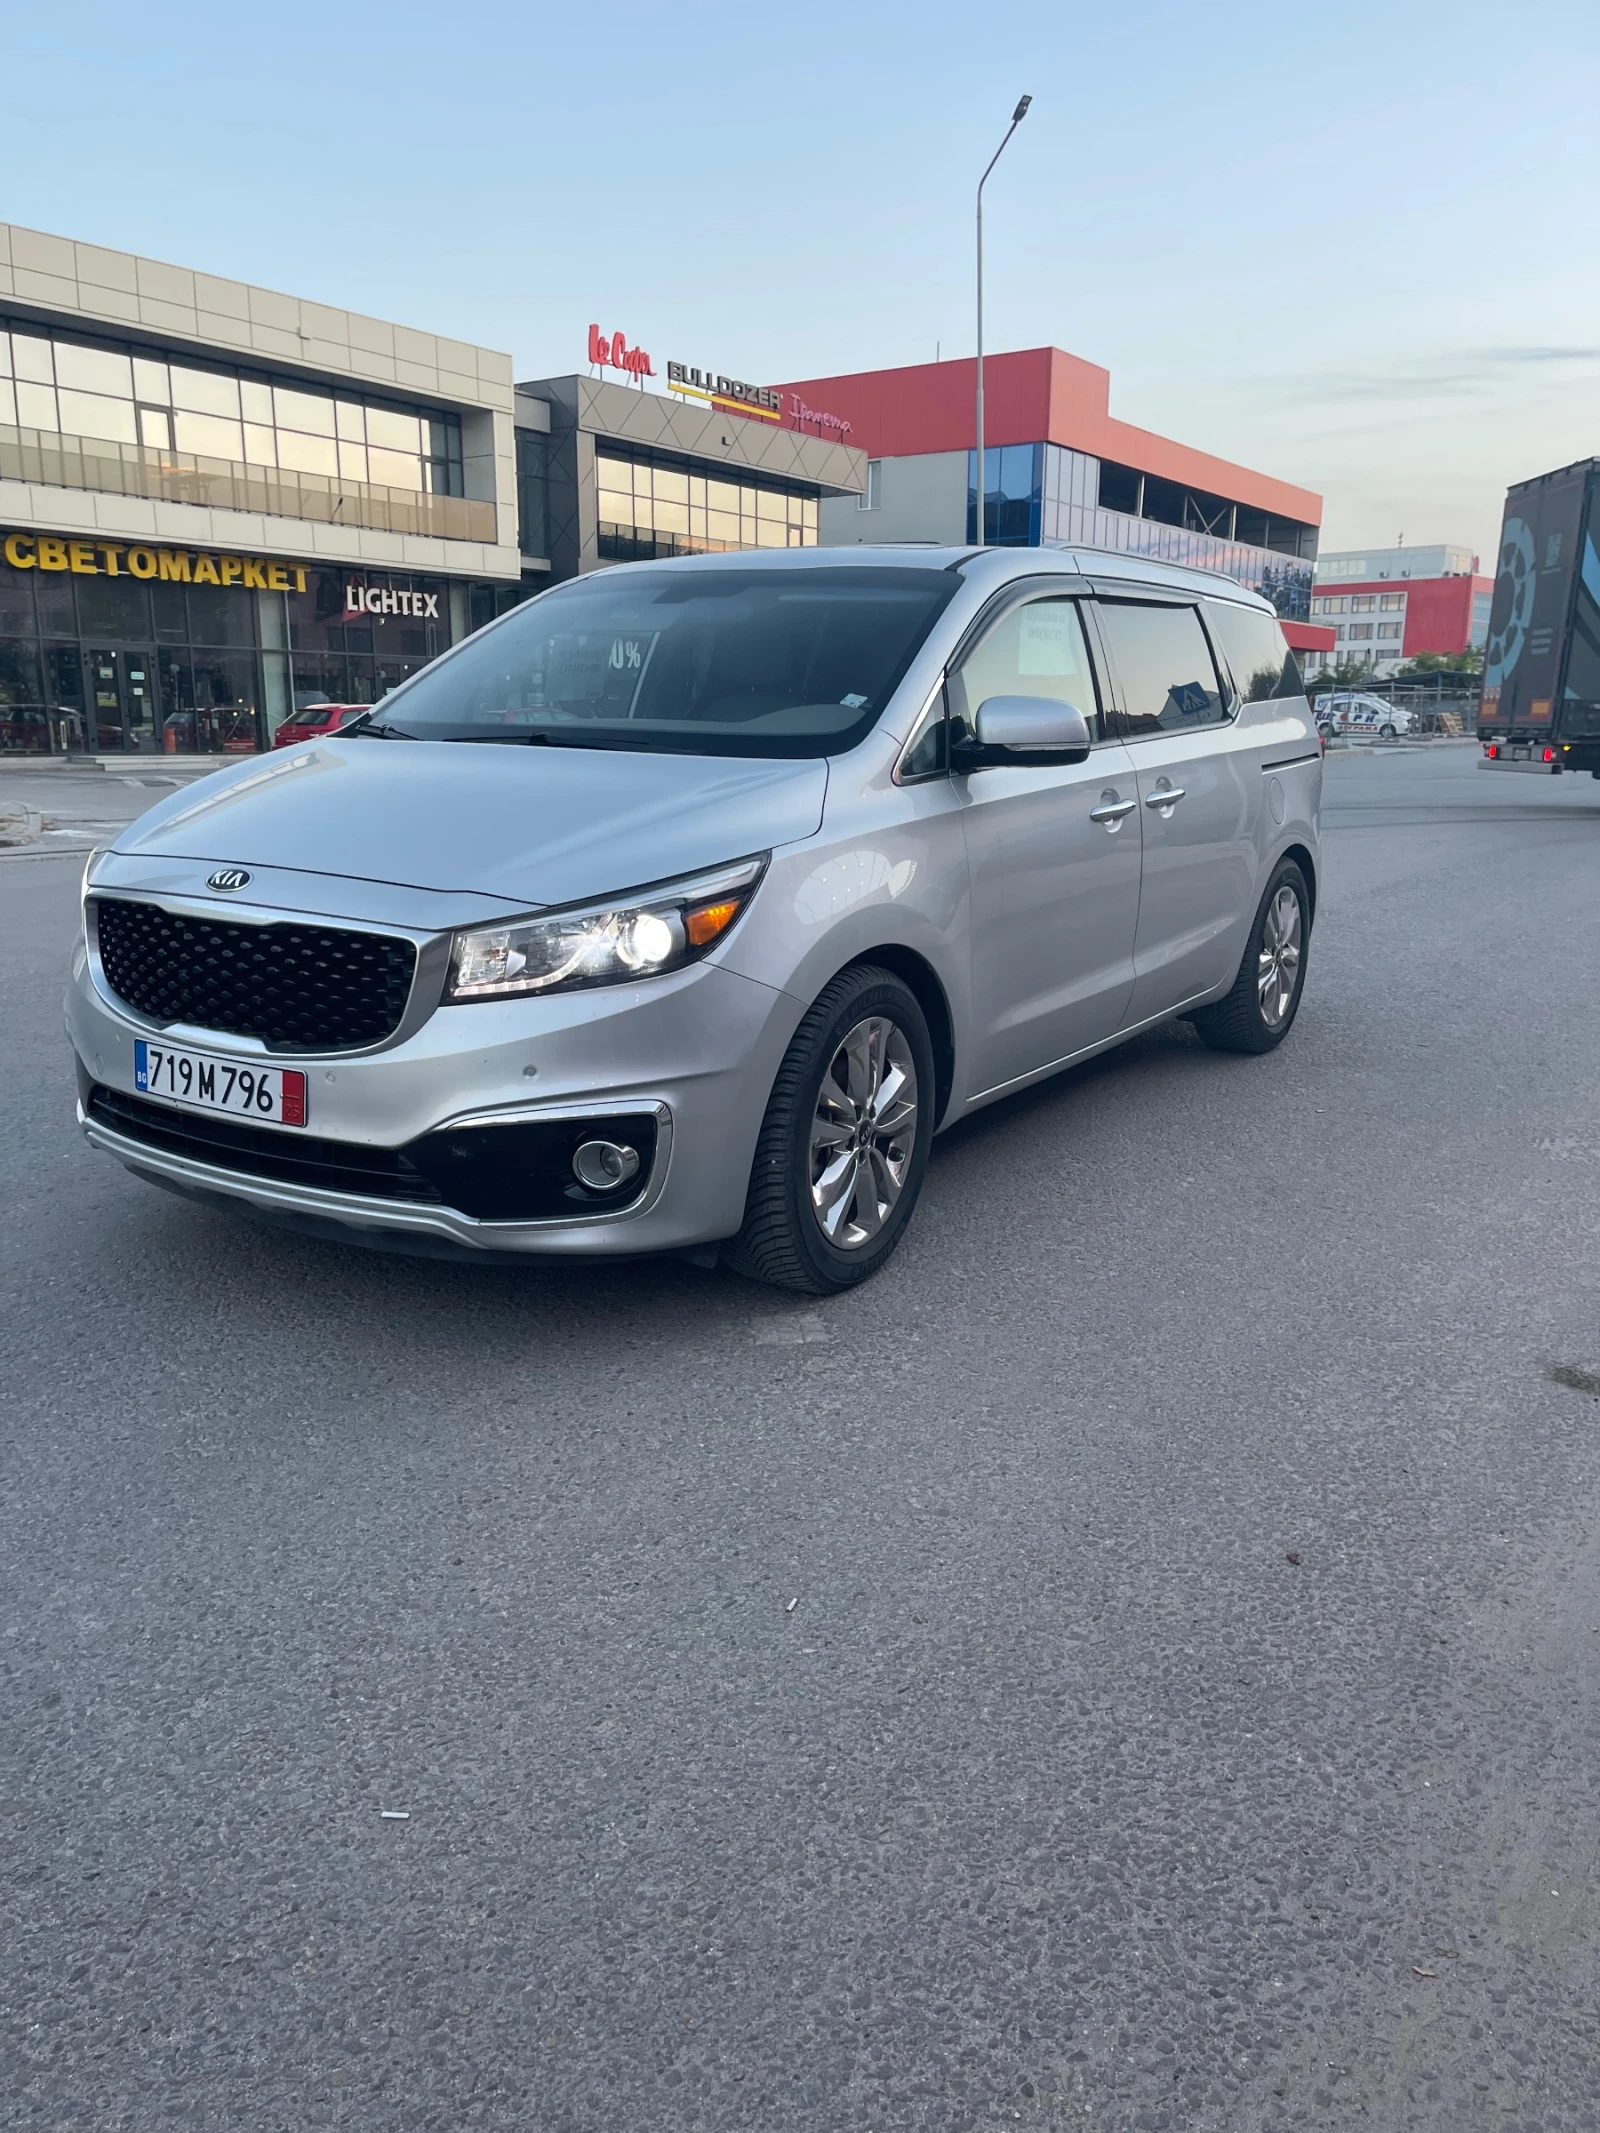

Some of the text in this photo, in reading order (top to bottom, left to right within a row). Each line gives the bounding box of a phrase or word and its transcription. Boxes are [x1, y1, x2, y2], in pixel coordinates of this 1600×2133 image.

[588, 323, 657, 382] Lee Cooper
[667, 361, 781, 410] BULLDOZER
[788, 392, 854, 434] Ipanema
[4, 533, 311, 593] СВЕТОМАРКЕТ
[346, 584, 439, 618] LIGHTEX
[210, 870, 244, 887] KIA
[137, 1071, 147, 1084] BG
[150, 1050, 273, 1112] 719M796
